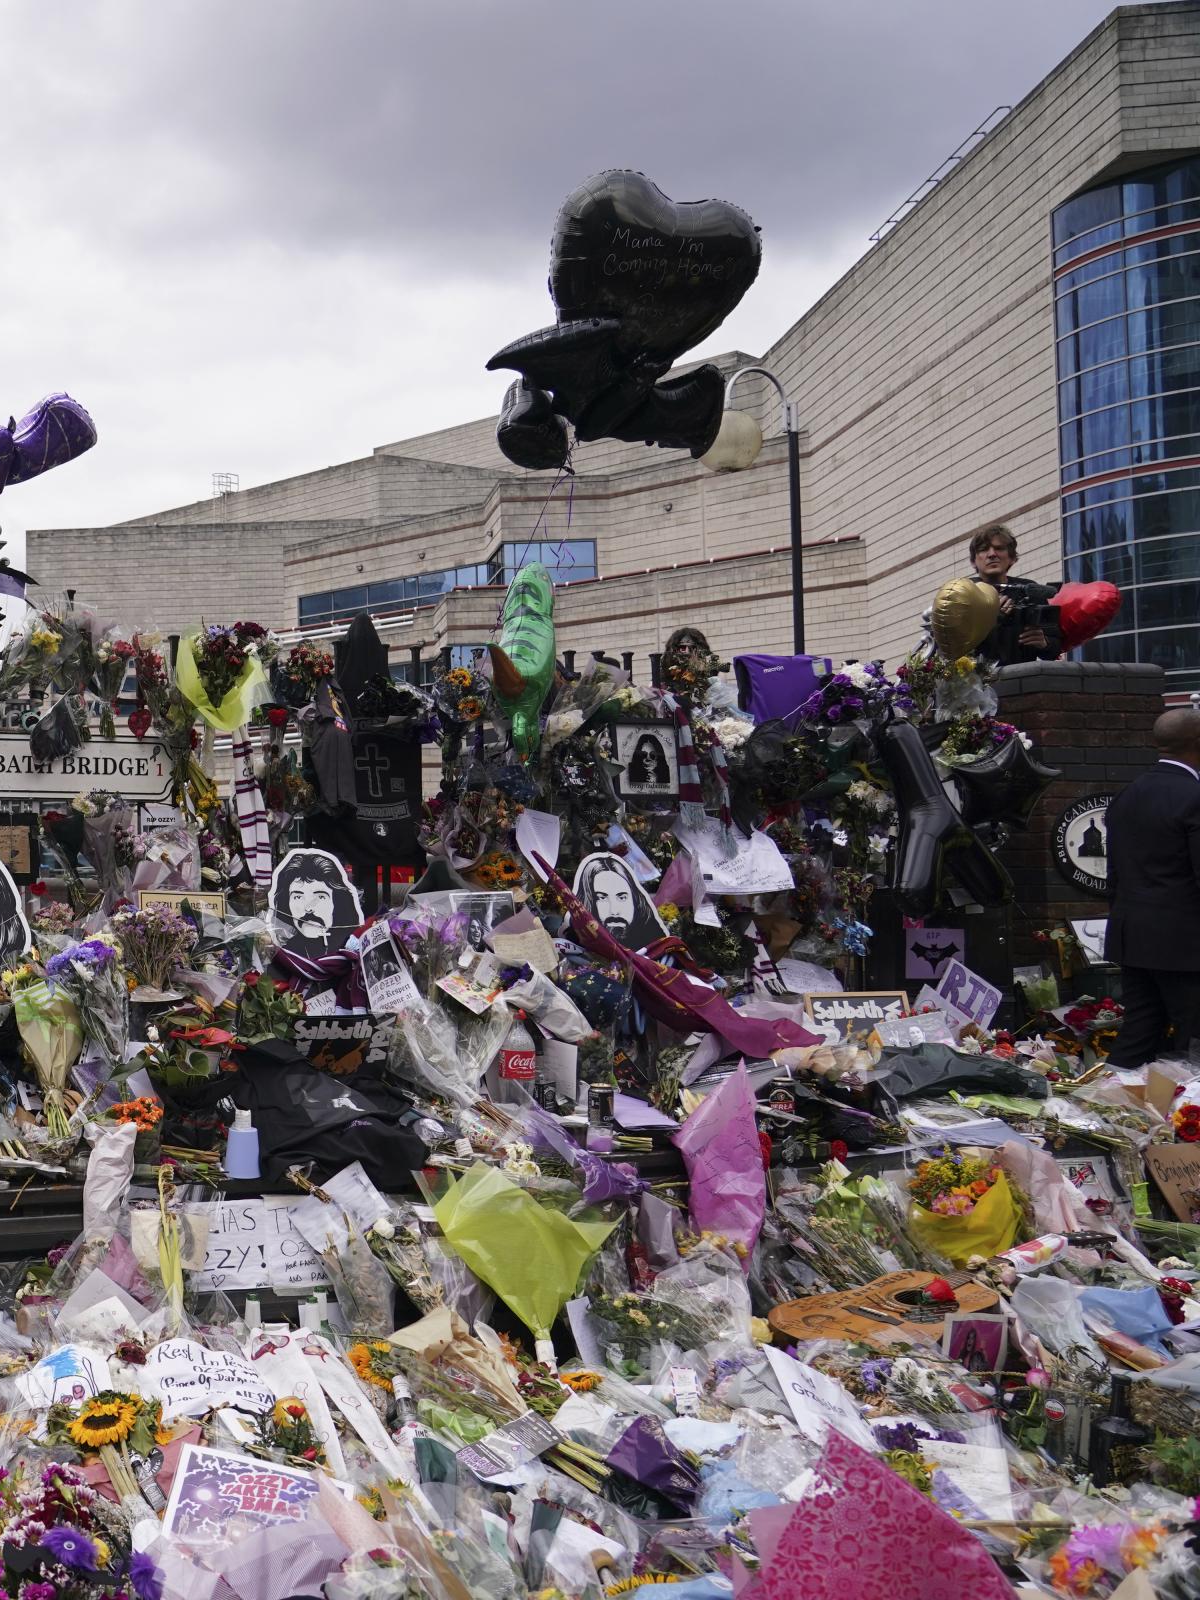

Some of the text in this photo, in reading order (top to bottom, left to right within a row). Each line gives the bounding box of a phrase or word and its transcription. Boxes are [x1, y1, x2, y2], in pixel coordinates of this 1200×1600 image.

[603, 253, 668, 284] Coming
[60, 756, 149, 777] BRIDGE
[1072, 869, 1107, 890] BROAD
[939, 962, 1000, 1026] RIP
[813, 1000, 885, 1020] Sabbath
[294, 1019, 373, 1040] Sabbath
[158, 1343, 194, 1363] Rest
[200, 1350, 220, 1367] In
[221, 1484, 279, 1499] TAKES
[238, 1474, 295, 1491] OZZY
[238, 1497, 303, 1519] BMAG
